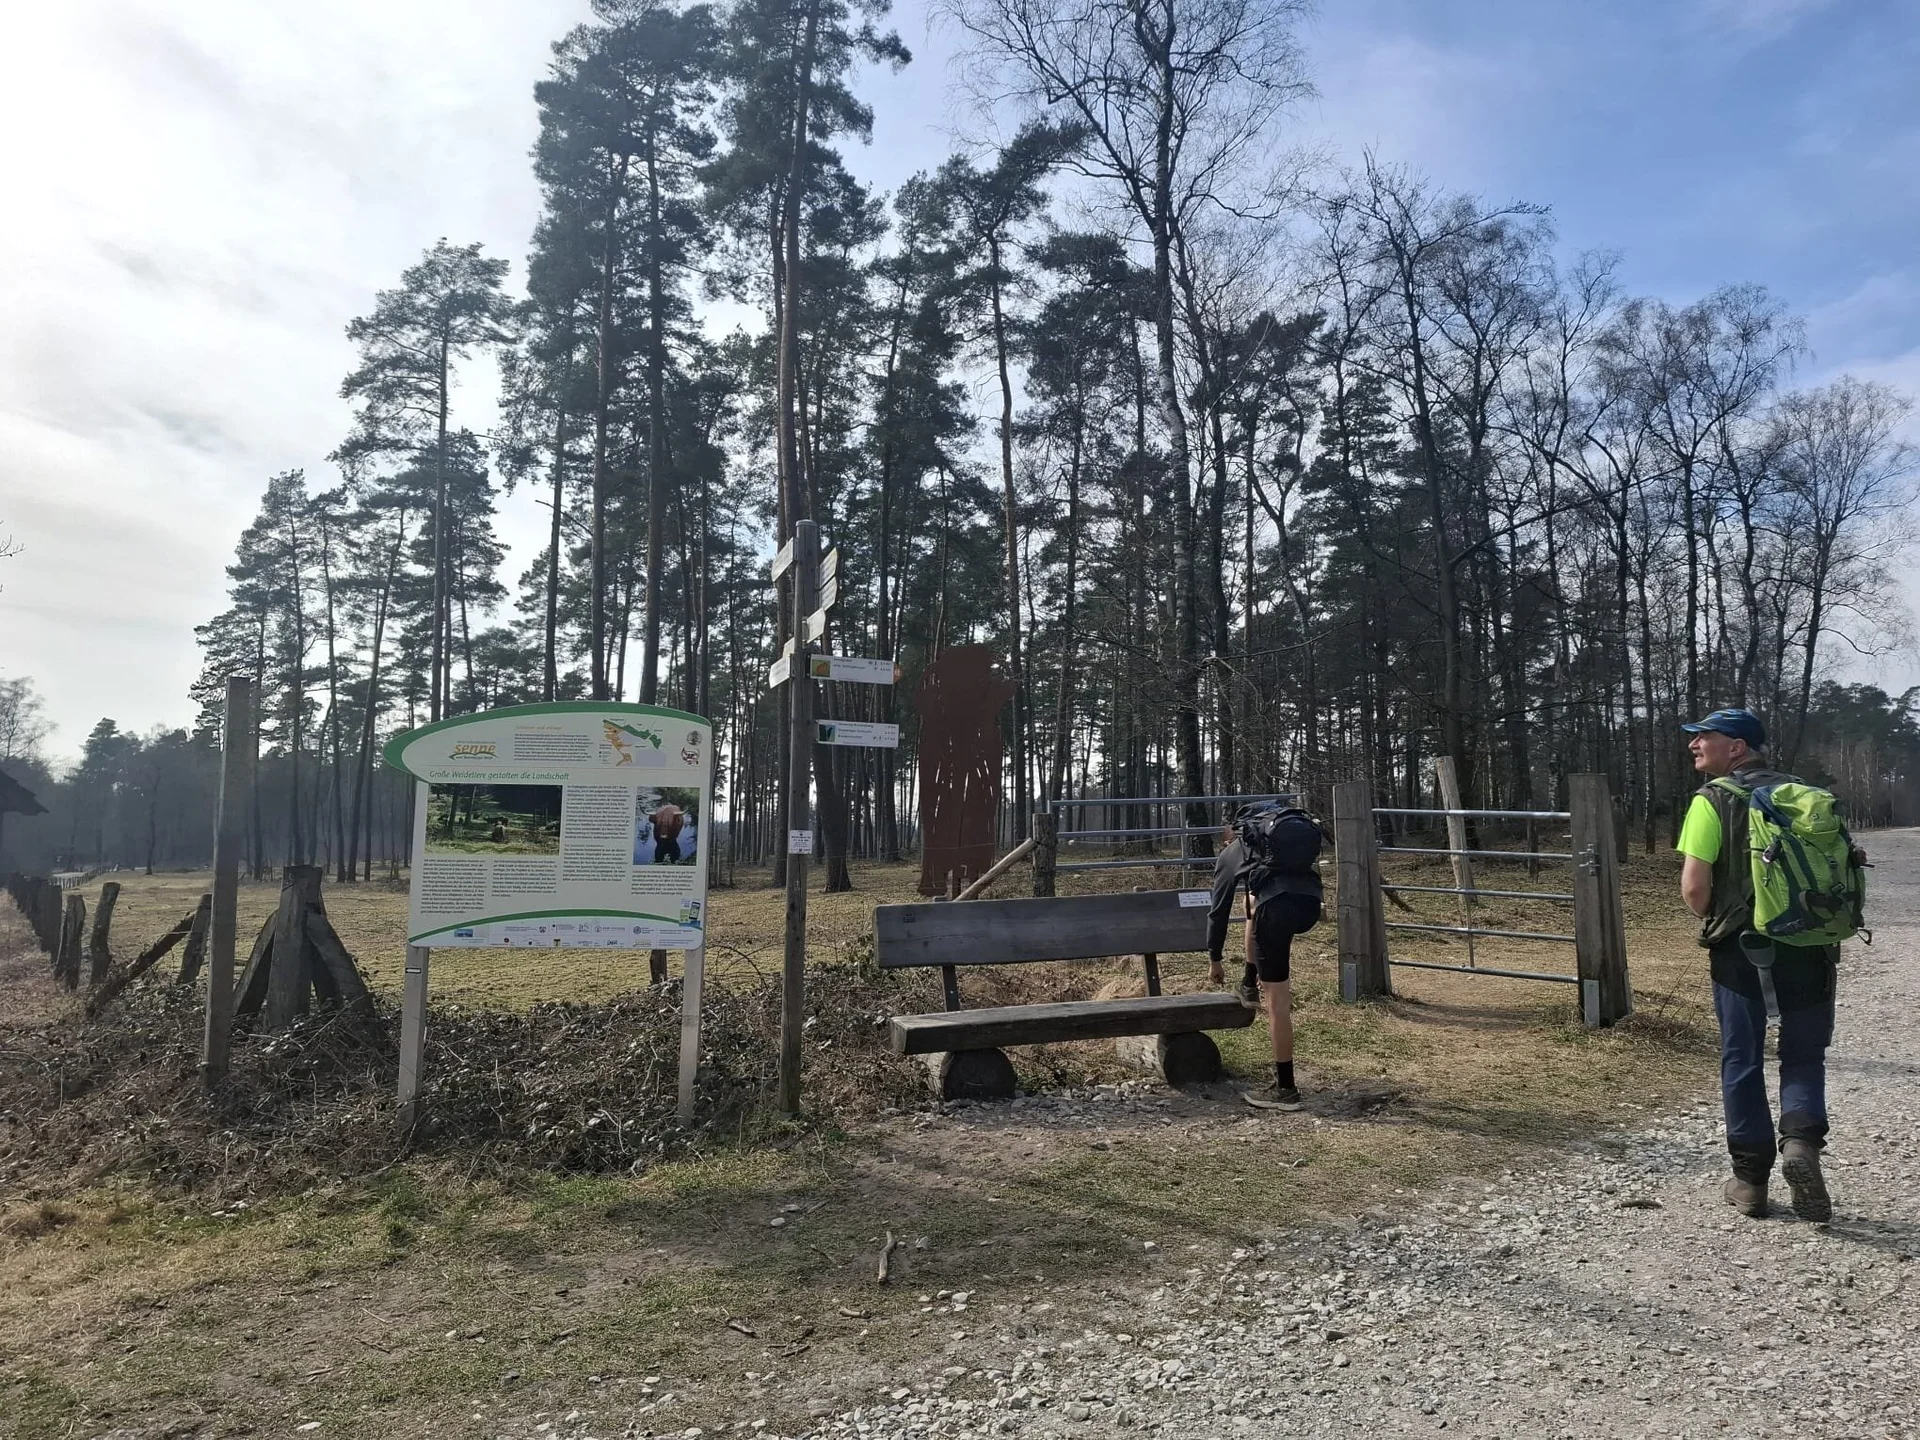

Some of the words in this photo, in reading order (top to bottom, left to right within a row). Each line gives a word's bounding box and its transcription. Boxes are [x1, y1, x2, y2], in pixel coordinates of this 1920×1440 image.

[454, 743, 497, 754] senne
[429, 770, 451, 779] Große
[452, 770, 487, 779] Weidetiere
[488, 770, 519, 781] gestalten
[520, 771, 530, 780] die
[532, 771, 570, 781] Landschaft
